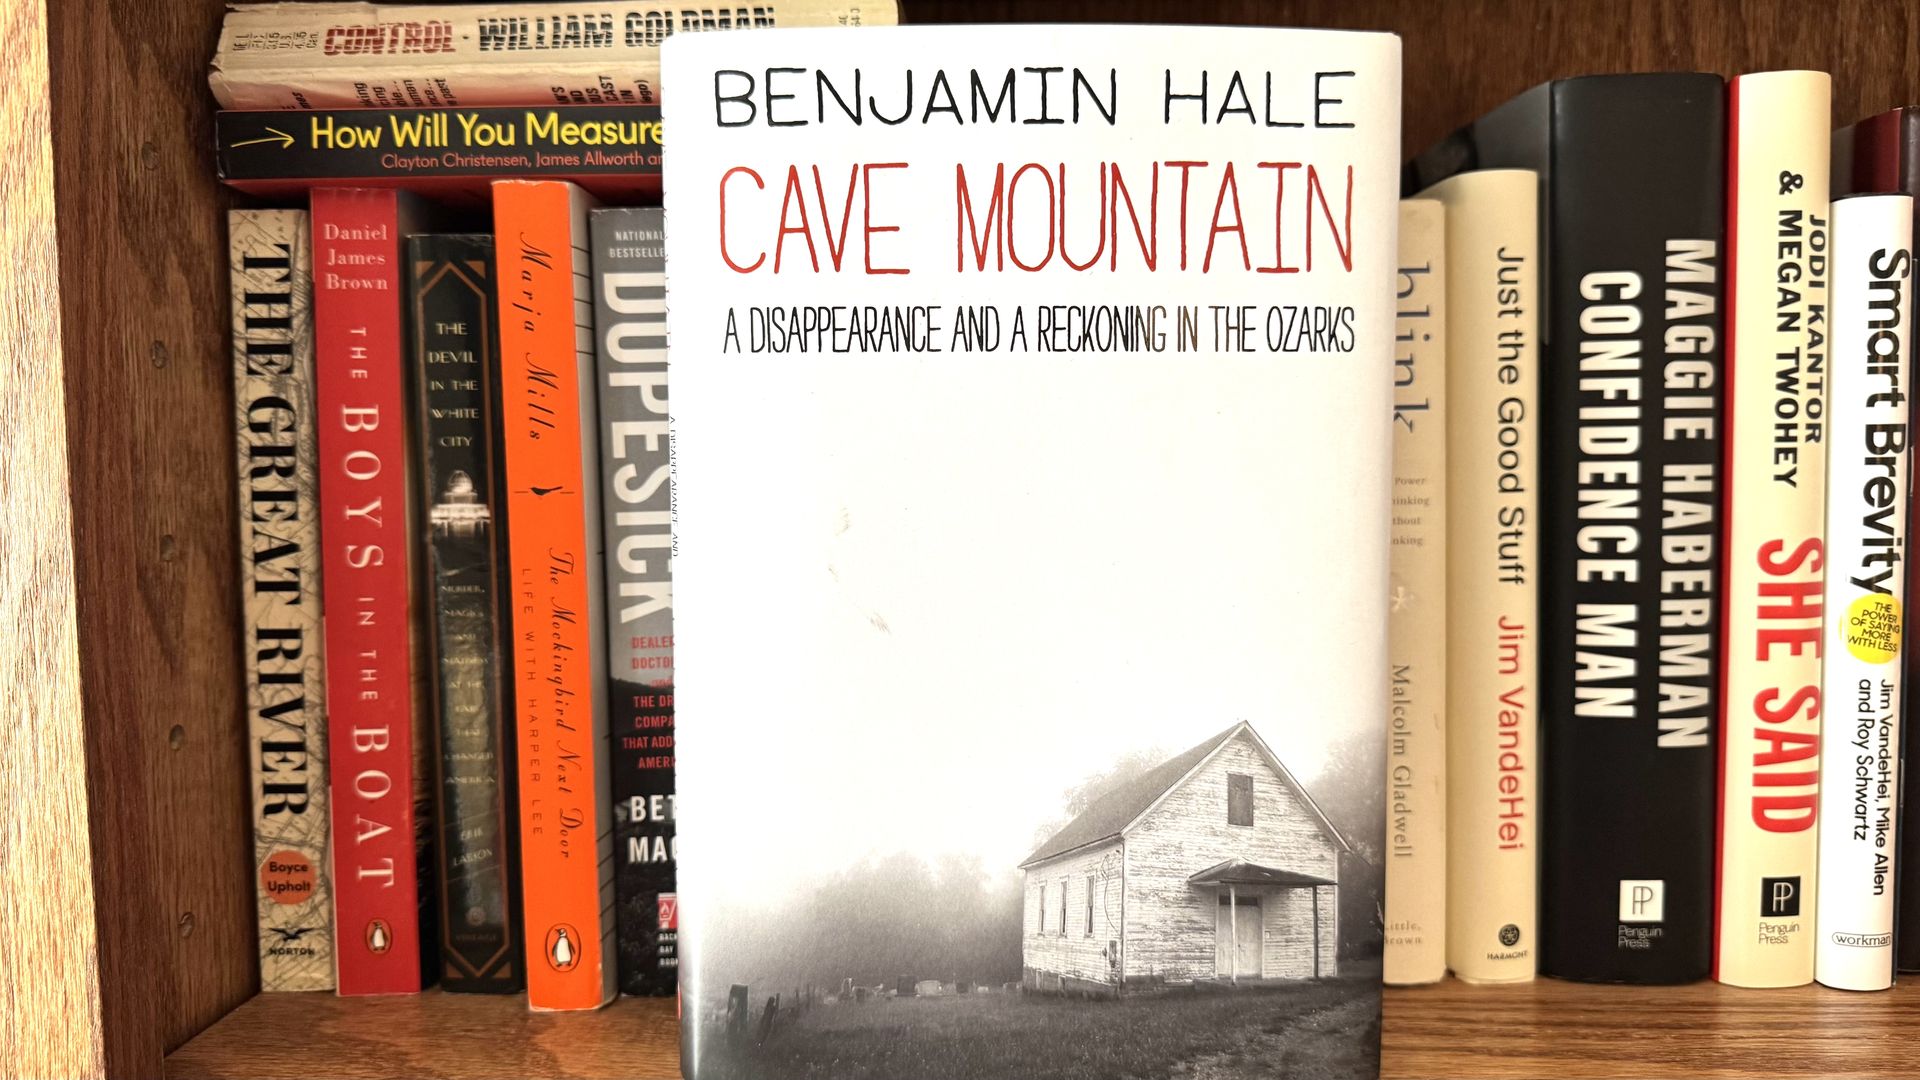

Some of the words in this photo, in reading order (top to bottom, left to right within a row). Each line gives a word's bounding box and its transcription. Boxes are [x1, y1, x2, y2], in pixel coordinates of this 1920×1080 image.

[323, 20, 456, 56] CONTROL
[478, 13, 614, 52] WILLIAM
[714, 66, 1117, 127] BENJAMIN
[1164, 69, 1356, 128] HALE
[311, 116, 382, 149] How
[390, 112, 448, 147] Will
[459, 114, 516, 148] You
[527, 112, 662, 146] Measure
[381, 153, 438, 171] Clayton
[442, 151, 532, 169] Christensen,
[536, 151, 580, 167] James
[584, 150, 644, 166] Allworth
[1778, 170, 1804, 196] &
[323, 223, 388, 241] Daniel
[615, 231, 664, 241] NATIONAL
[719, 162, 910, 275] CAVE
[957, 161, 1354, 274] MOUNTAIN
[326, 247, 386, 266] James
[609, 247, 665, 258] BESTSELLE
[1775, 209, 1803, 333] MEGAN
[1808, 214, 1827, 289] JODI
[325, 273, 389, 291] Brown
[512, 231, 553, 333] Marja
[1496, 246, 1525, 318] Just
[243, 243, 295, 376] THE
[435, 322, 468, 336] THE
[723, 307, 741, 354] A
[749, 305, 942, 354] DISAPPEARANCE
[951, 305, 1000, 354] AND
[1010, 306, 1028, 353] A
[1037, 305, 1167, 353] RECKONING
[1177, 305, 1198, 353] IN
[1208, 305, 1257, 353] THE
[1266, 305, 1356, 353] OZARKS
[1865, 247, 1911, 409] Smart
[349, 326, 368, 379] THE
[428, 351, 478, 364] DEVIL
[1393, 261, 1432, 434] blink
[1497, 329, 1525, 386] the
[1663, 239, 1717, 441] MAGGIE
[431, 380, 445, 391] IN
[452, 379, 479, 391] THE
[524, 351, 559, 441] Mills
[1804, 303, 1826, 444] KANTOR
[431, 408, 480, 419] WHITE
[1576, 270, 1643, 584] CONFIDENCE
[1773, 346, 1801, 488] TWOHEY
[441, 436, 472, 447] CITY
[1497, 396, 1525, 494] Good
[248, 395, 301, 607] GREAT
[342, 404, 385, 569] BOYS
[1849, 423, 1907, 596] Brevity
[548, 547, 575, 586] The
[1498, 505, 1525, 585] Stuff
[357, 597, 376, 626] IN
[522, 567, 534, 614] LIFE
[1656, 463, 1714, 749] HABERMAN
[1755, 537, 1824, 662] SHE
[1875, 601, 1892, 613] THE
[1850, 616, 1867, 627] OF
[1868, 620, 1900, 634] SAYING
[1861, 628, 1892, 642] MORE
[1862, 609, 1897, 623] POWER
[526, 630, 537, 681] WITH
[546, 596, 576, 732] Mockingbird
[1497, 615, 1527, 675] Jim
[1574, 603, 1639, 718] MAN
[1848, 634, 1877, 649] WITH
[1878, 641, 1897, 653] LESS
[360, 649, 378, 700] THE
[1857, 678, 1875, 714] and
[1880, 678, 1894, 710] Jim
[255, 626, 310, 819] RIVER
[633, 695, 655, 708] THE
[659, 694, 674, 707] DR
[635, 715, 674, 728] COMPA
[1392, 663, 1411, 757] Malcolm
[529, 698, 541, 784] HARPER
[623, 736, 648, 749] THAT
[651, 735, 675, 748] ADD
[1851, 717, 1876, 750] Roy
[556, 739, 583, 794] Next
[1497, 685, 1527, 851] VandeHei
[1751, 683, 1822, 834] SAID
[1874, 714, 1894, 803] VandeHei,
[352, 724, 396, 888] BOAT
[532, 799, 543, 836] LEE
[630, 794, 677, 823] BET
[1393, 764, 1413, 858] Gladwell
[1853, 754, 1875, 841] Schwartz
[558, 806, 585, 859] Door
[1875, 806, 1891, 848] Mike
[268, 880, 310, 894] Upholt
[269, 861, 308, 875] Boyce
[1872, 852, 1889, 896] Allen
[269, 947, 315, 955] NORTON
[1617, 936, 1650, 948] Press
[1618, 925, 1662, 939] Penguin
[1758, 933, 1789, 944] Press
[1759, 922, 1800, 935] Penguin
[1836, 934, 1891, 946] workman
